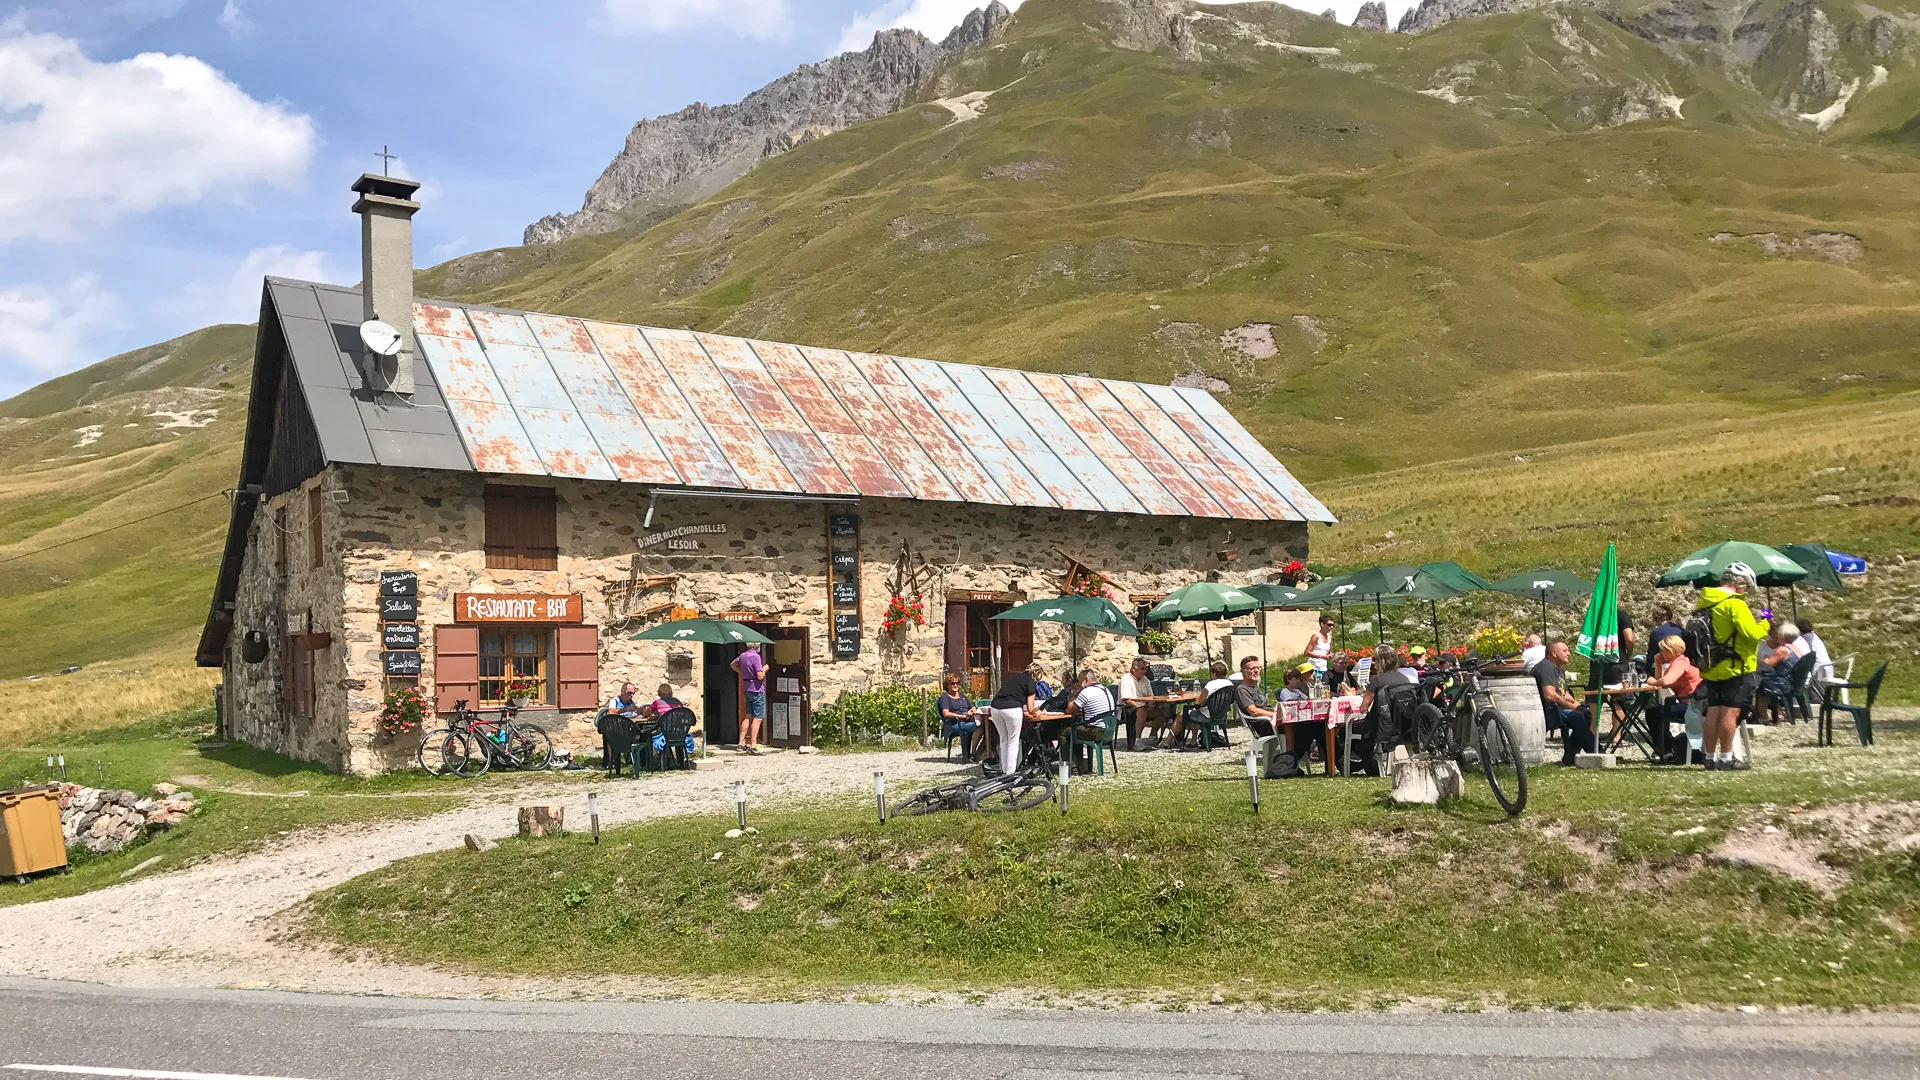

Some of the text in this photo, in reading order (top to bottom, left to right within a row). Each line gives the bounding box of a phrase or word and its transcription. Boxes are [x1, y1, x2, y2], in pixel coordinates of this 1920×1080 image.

[383, 599, 412, 613] Salades
[386, 624, 417, 632] omelettes
[837, 636, 853, 644] Pain
